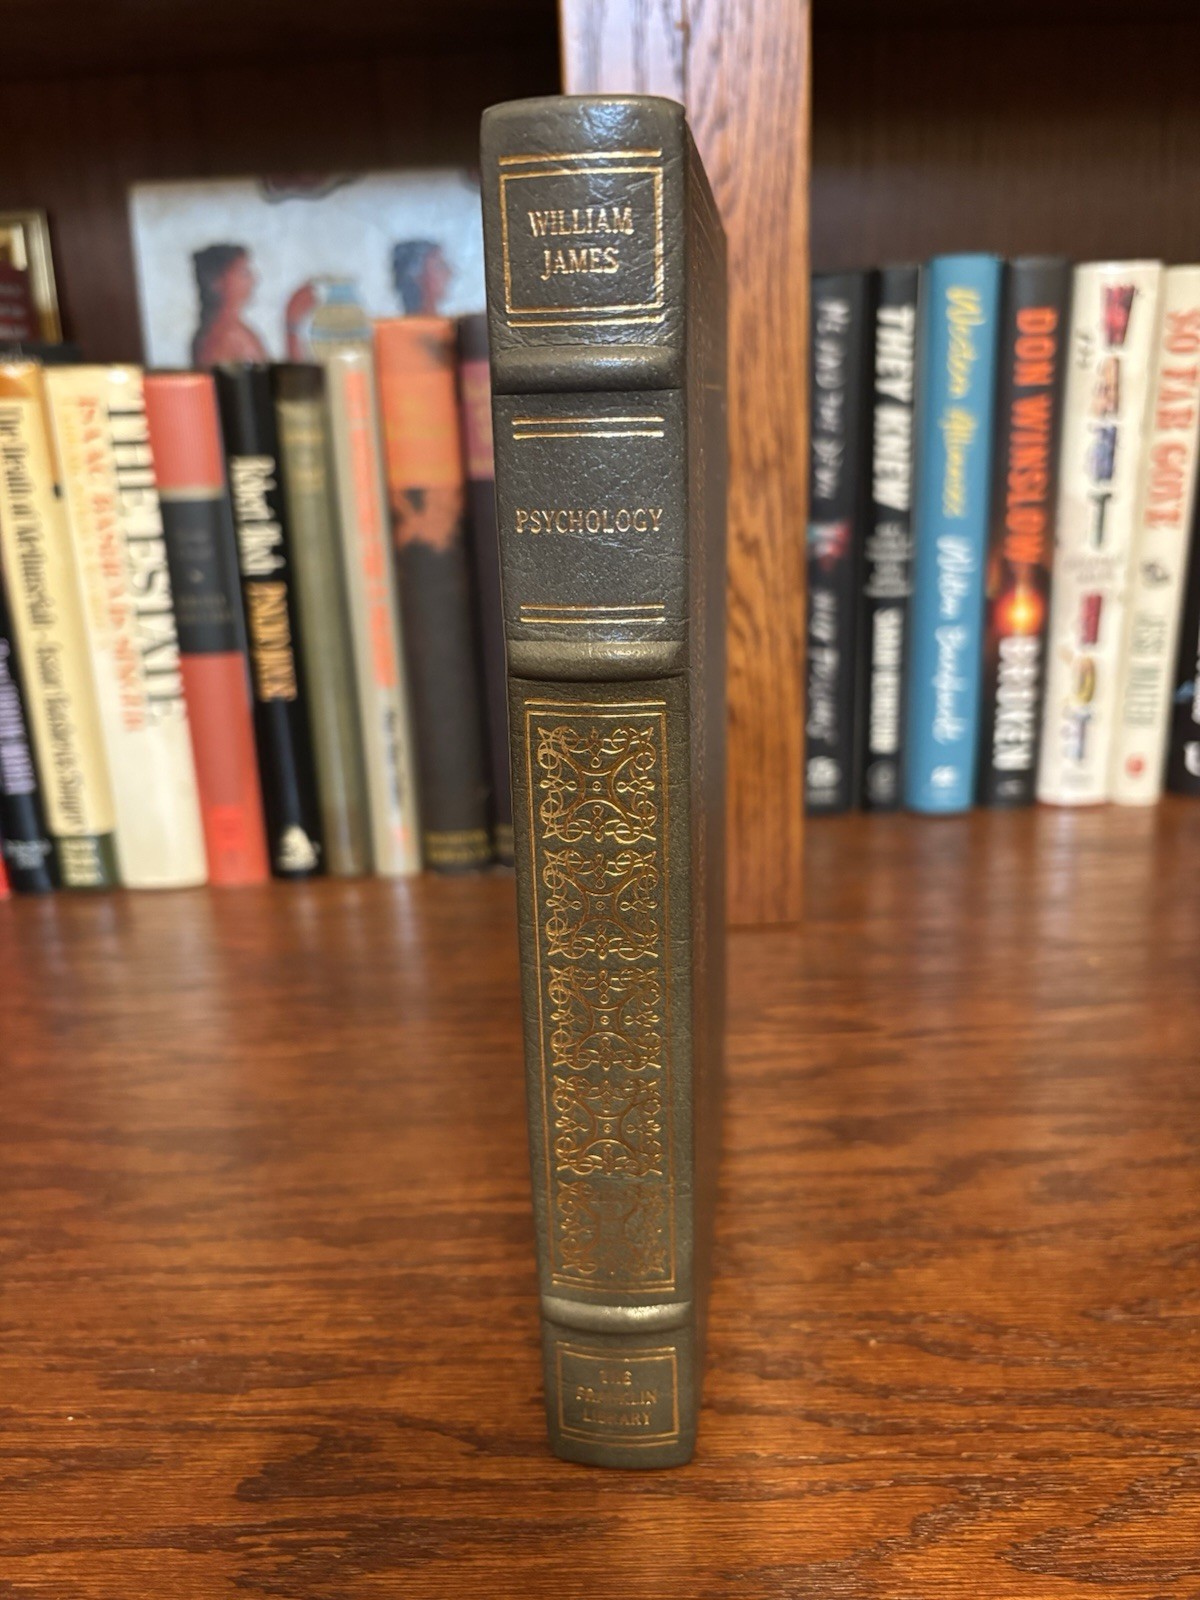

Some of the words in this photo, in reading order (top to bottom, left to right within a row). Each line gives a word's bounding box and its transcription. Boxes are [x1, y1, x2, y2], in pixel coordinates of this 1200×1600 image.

[527, 206, 635, 238] WILLIAM
[540, 246, 620, 281] JAMES
[874, 304, 916, 404] THEY
[1013, 307, 1058, 387] DON
[106, 398, 160, 516] THE
[872, 403, 913, 512] KNEW
[1004, 391, 1053, 565] WINSLOW
[515, 508, 664, 535] PSYCHOLOGY
[123, 531, 185, 727] ESTATE
[992, 636, 1041, 770] BROKEN
